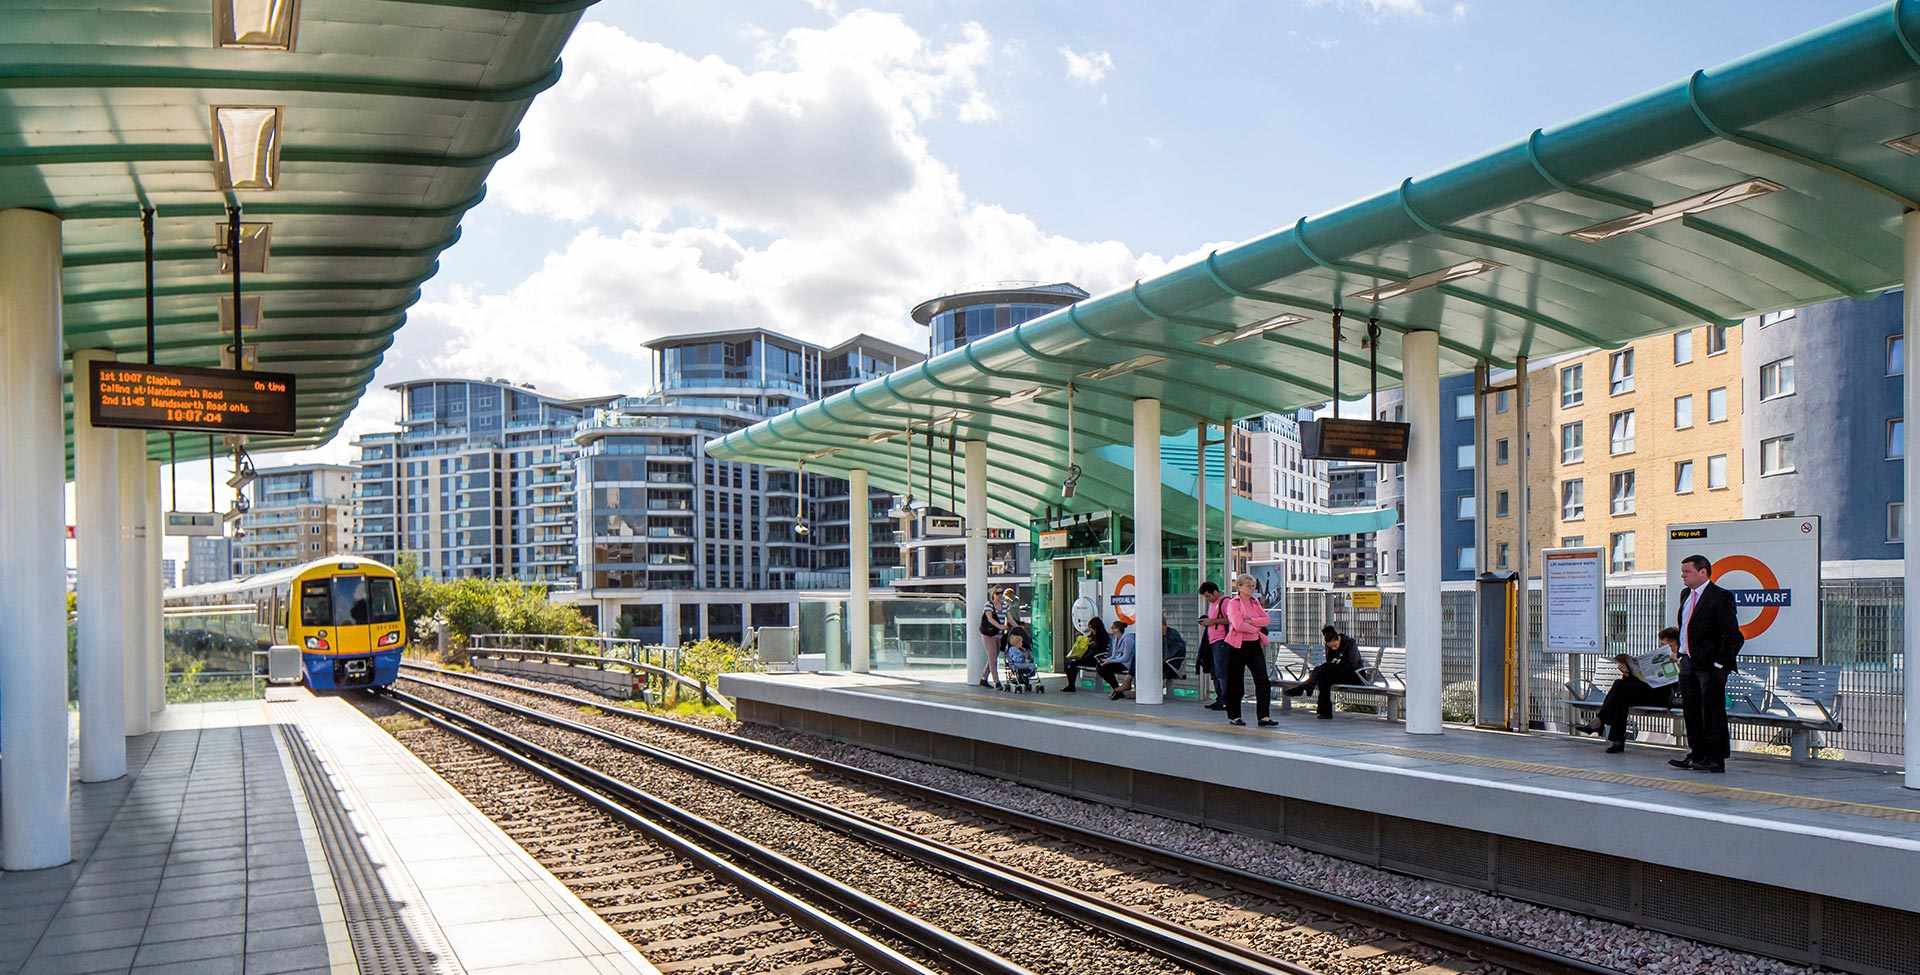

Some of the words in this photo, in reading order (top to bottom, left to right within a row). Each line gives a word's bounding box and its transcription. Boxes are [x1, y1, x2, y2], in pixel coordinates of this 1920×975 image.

[100, 383, 131, 394] Calling
[147, 386, 200, 398] Wandsworth
[202, 389, 224, 399] Road
[146, 375, 182, 386] Clapham
[254, 381, 265, 391] On
[268, 382, 286, 392] time
[102, 395, 119, 405] 2nd
[151, 397, 204, 410] Wandsworth
[206, 401, 227, 411] Road
[1745, 593, 1788, 603] WHARF
